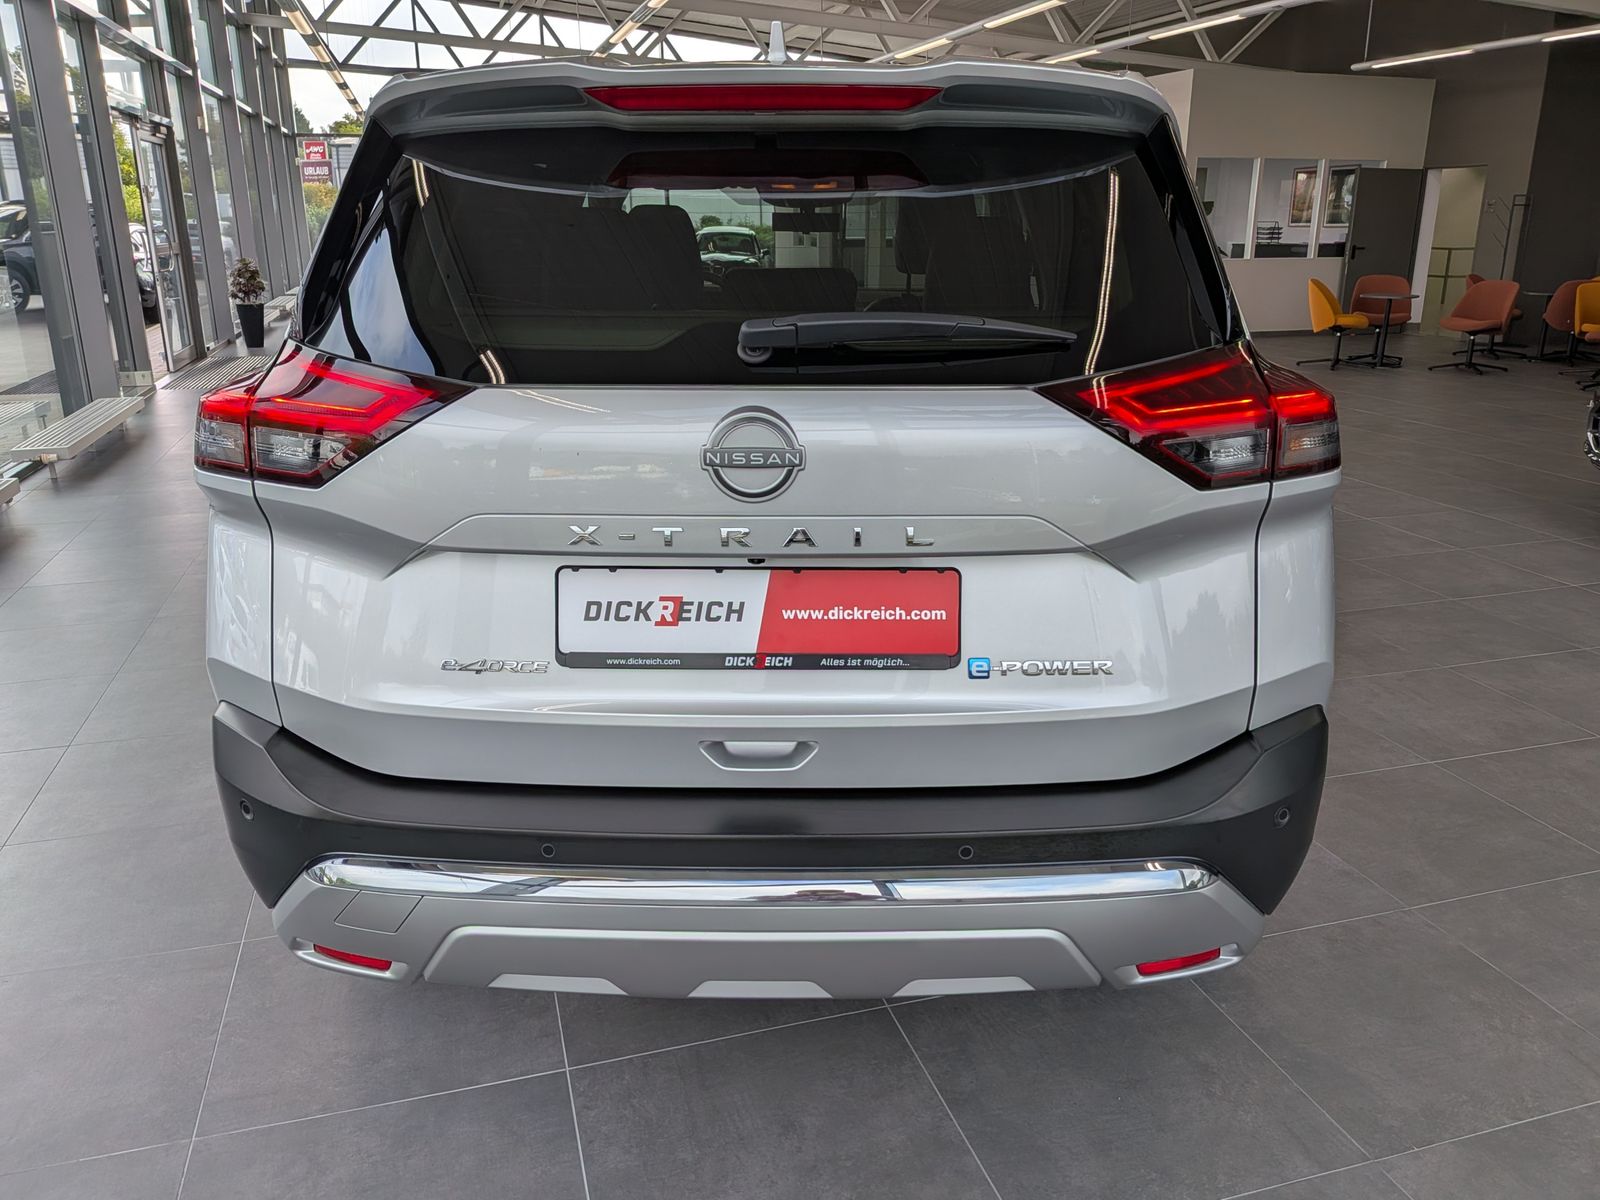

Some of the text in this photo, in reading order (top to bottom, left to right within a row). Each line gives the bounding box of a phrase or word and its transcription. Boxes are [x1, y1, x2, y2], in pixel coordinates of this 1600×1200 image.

[303, 166, 329, 175] URLAUB
[706, 452, 800, 465] NISSAN
[567, 525, 935, 548] X-TRAIL
[583, 596, 745, 626] DICKREICH
[781, 606, 947, 621] www.dickreich.com
[606, 657, 681, 666] www.dickreich.com
[724, 655, 793, 668] DICKEICH
[820, 657, 845, 666] Alles
[847, 657, 862, 666] ist
[968, 657, 1114, 679] e-POWER
